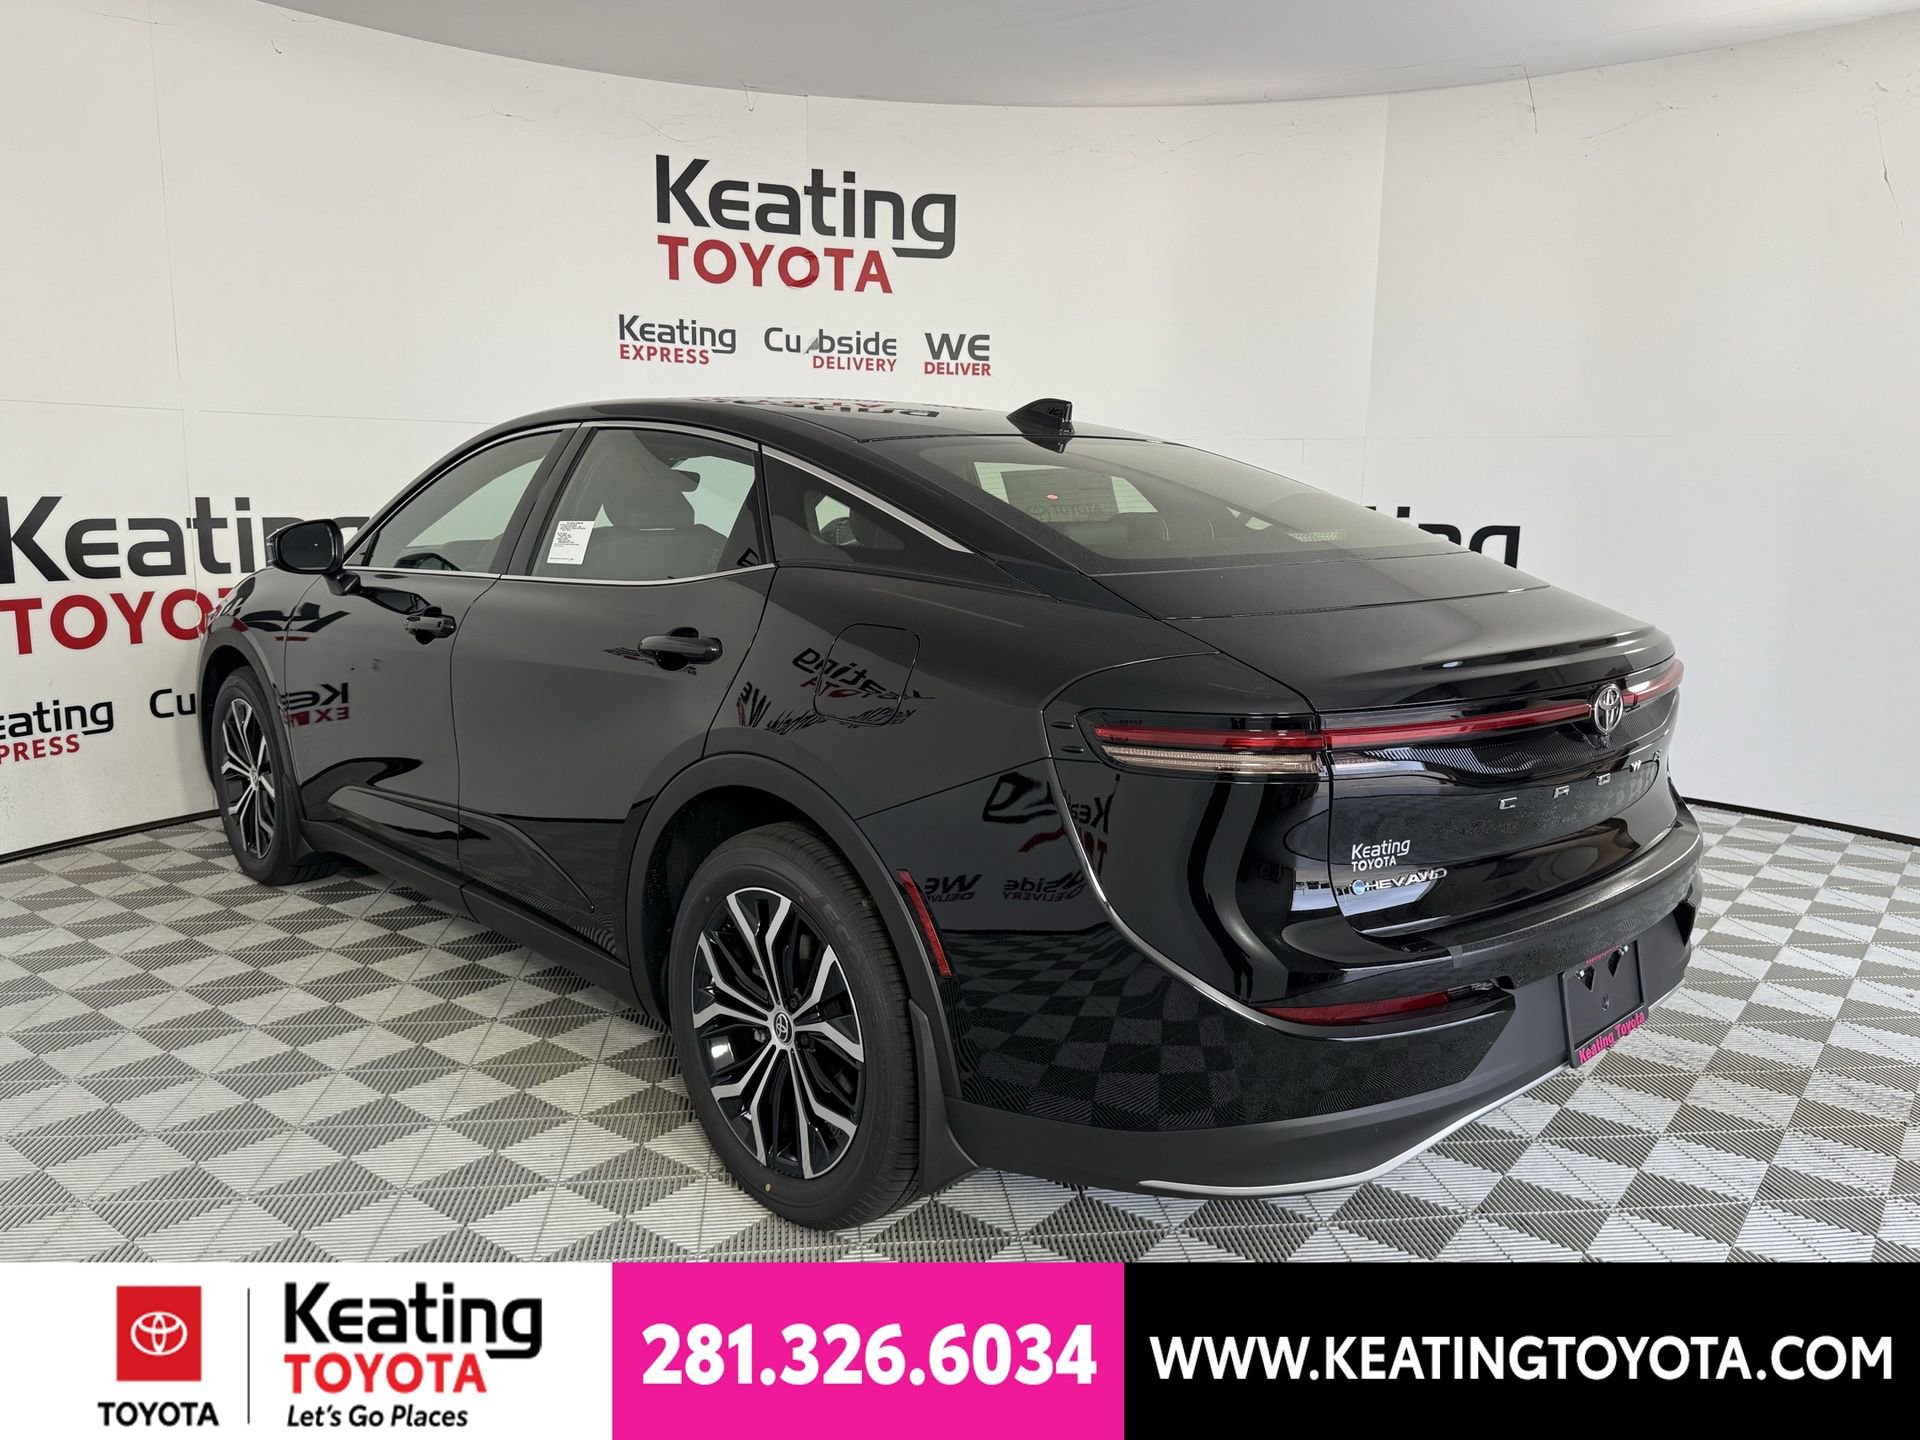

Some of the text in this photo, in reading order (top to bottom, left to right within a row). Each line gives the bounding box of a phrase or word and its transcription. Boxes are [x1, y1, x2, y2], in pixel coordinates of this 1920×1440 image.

[655, 154, 957, 259] Keating
[657, 234, 893, 294] TOYOTA
[618, 313, 736, 354] Keating
[763, 326, 898, 356] Cubside
[619, 344, 710, 365] EXPRESS
[812, 355, 898, 372] DELIVERY
[923, 361, 992, 376] DELIVER
[0, 699, 114, 739] ating
[1351, 839, 1411, 860] Keating
[1351, 856, 1397, 872] TOYOTA
[1577, 1011, 1645, 1064] Keating Toyota
